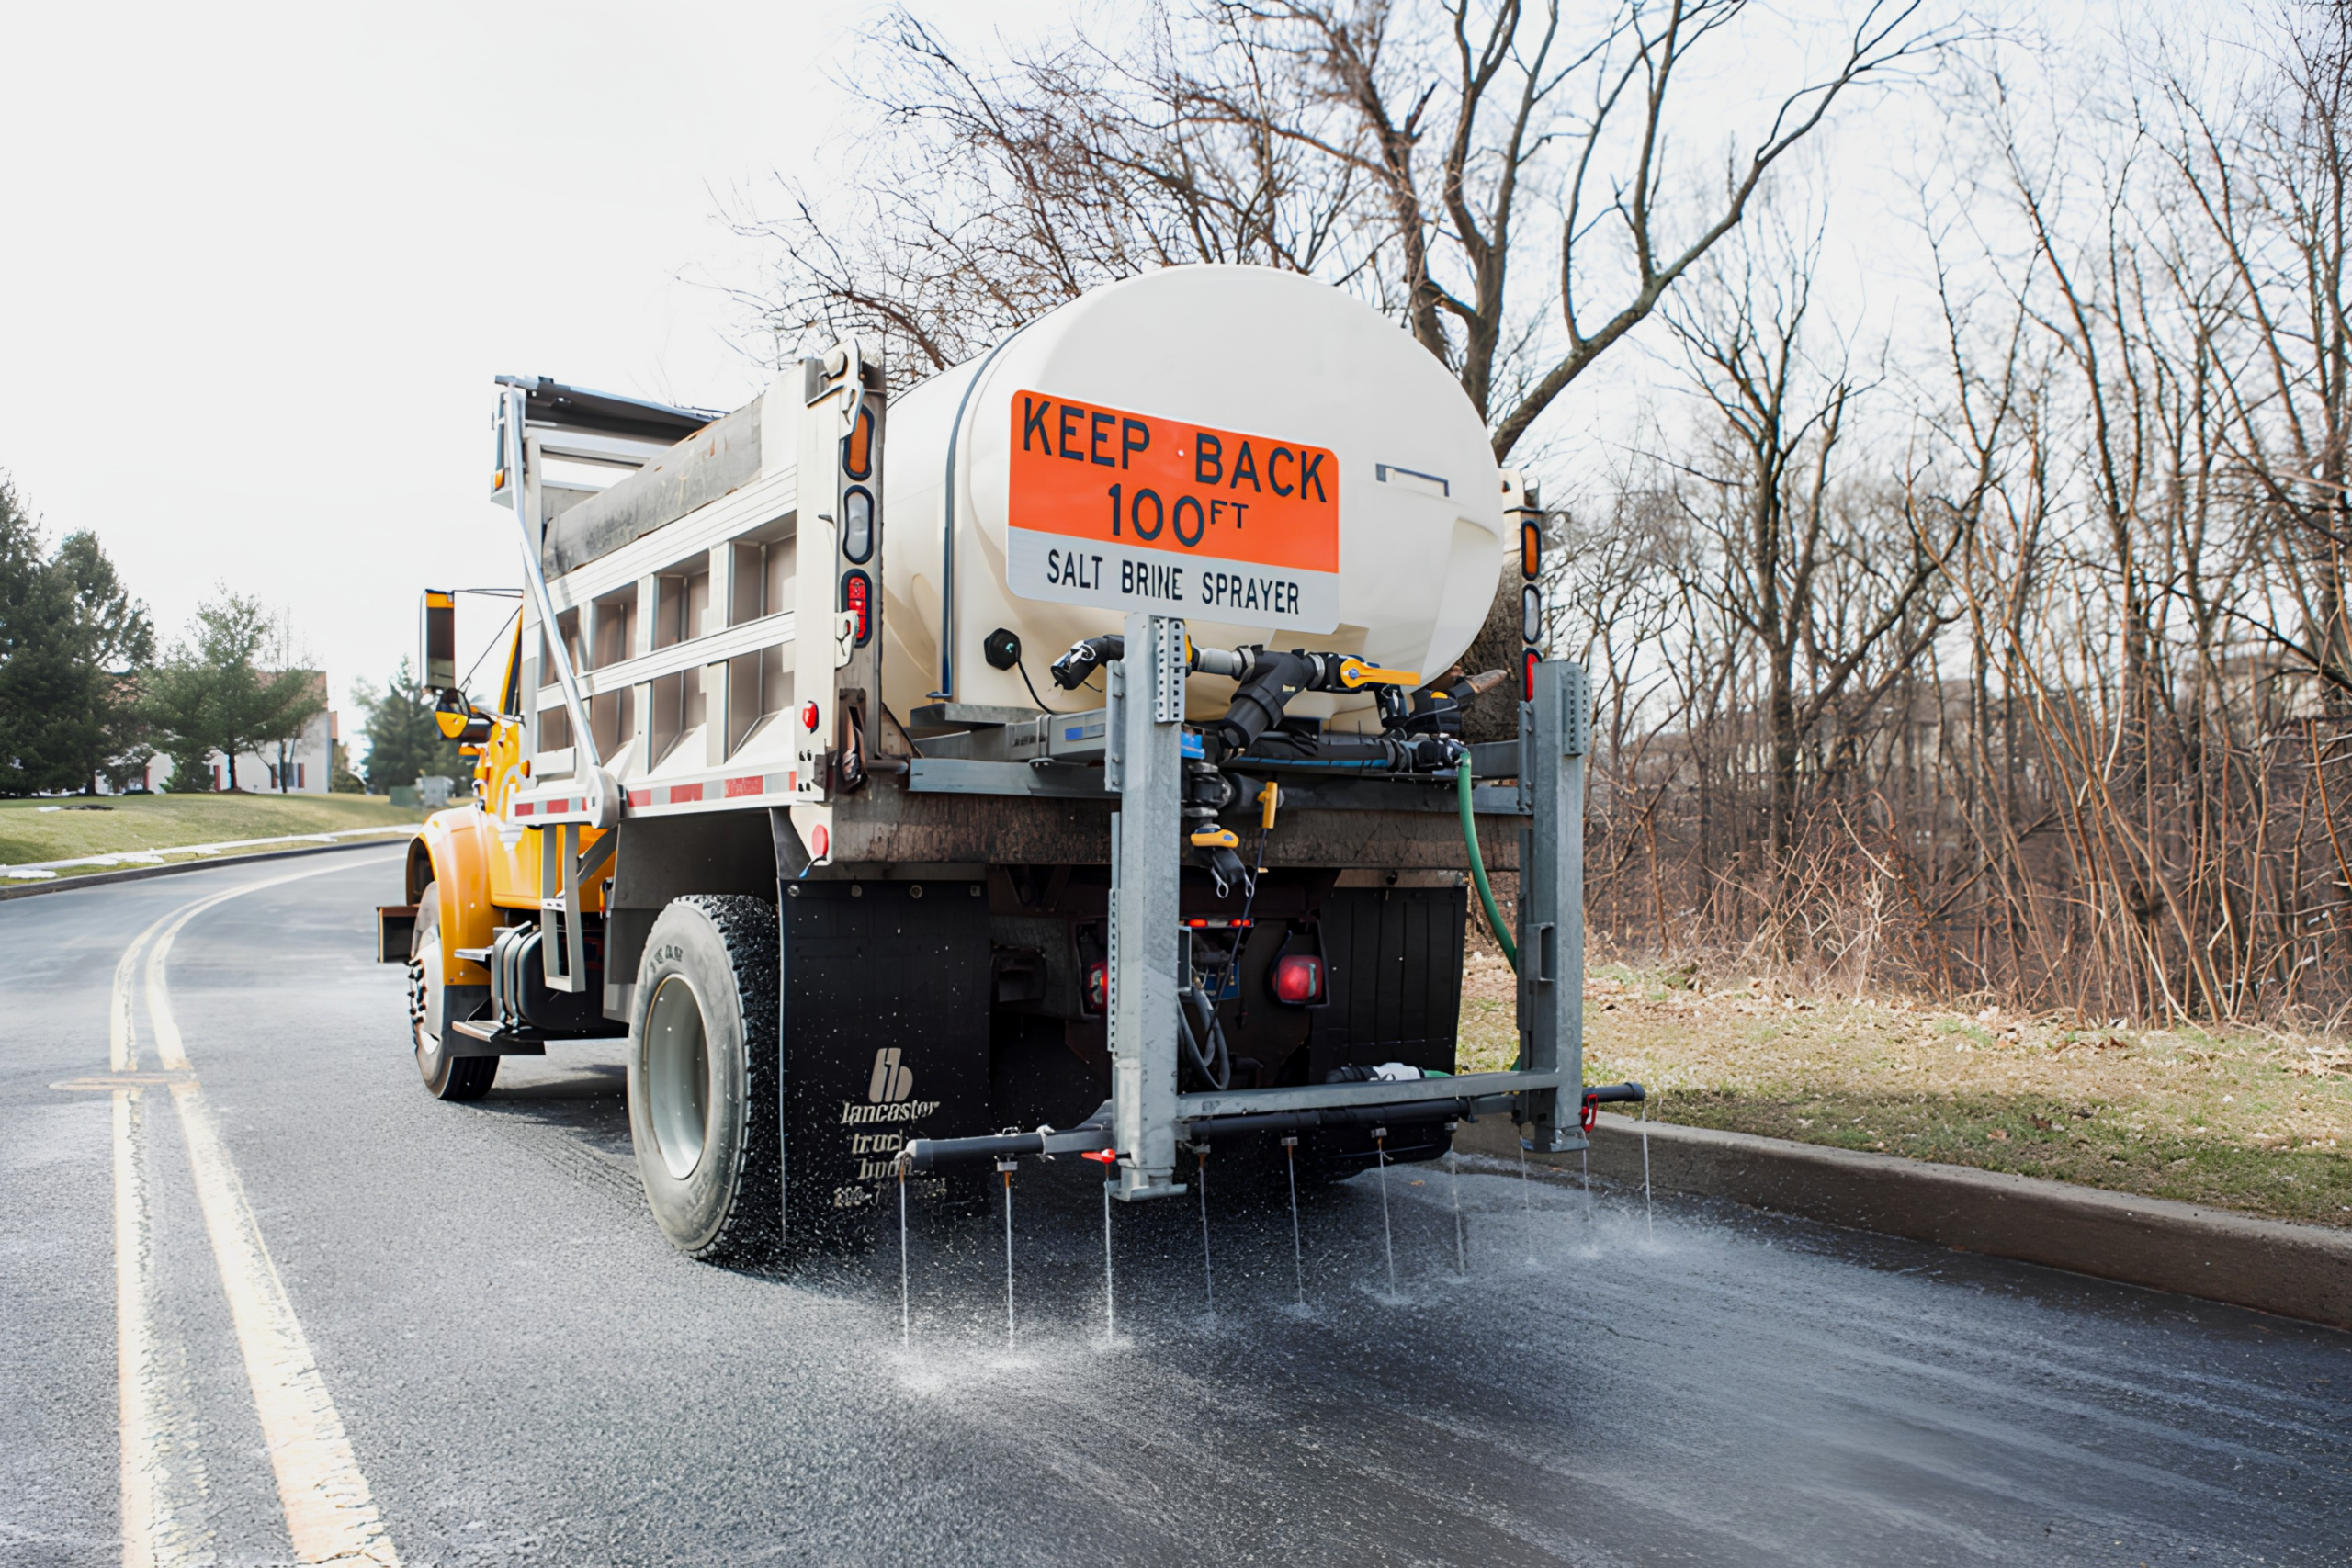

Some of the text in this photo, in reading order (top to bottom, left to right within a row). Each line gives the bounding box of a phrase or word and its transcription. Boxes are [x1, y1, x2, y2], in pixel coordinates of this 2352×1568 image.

[1023, 397, 1328, 503] KEEP BACK
[1046, 548, 1300, 615] SALT BRINE SPRAYER
